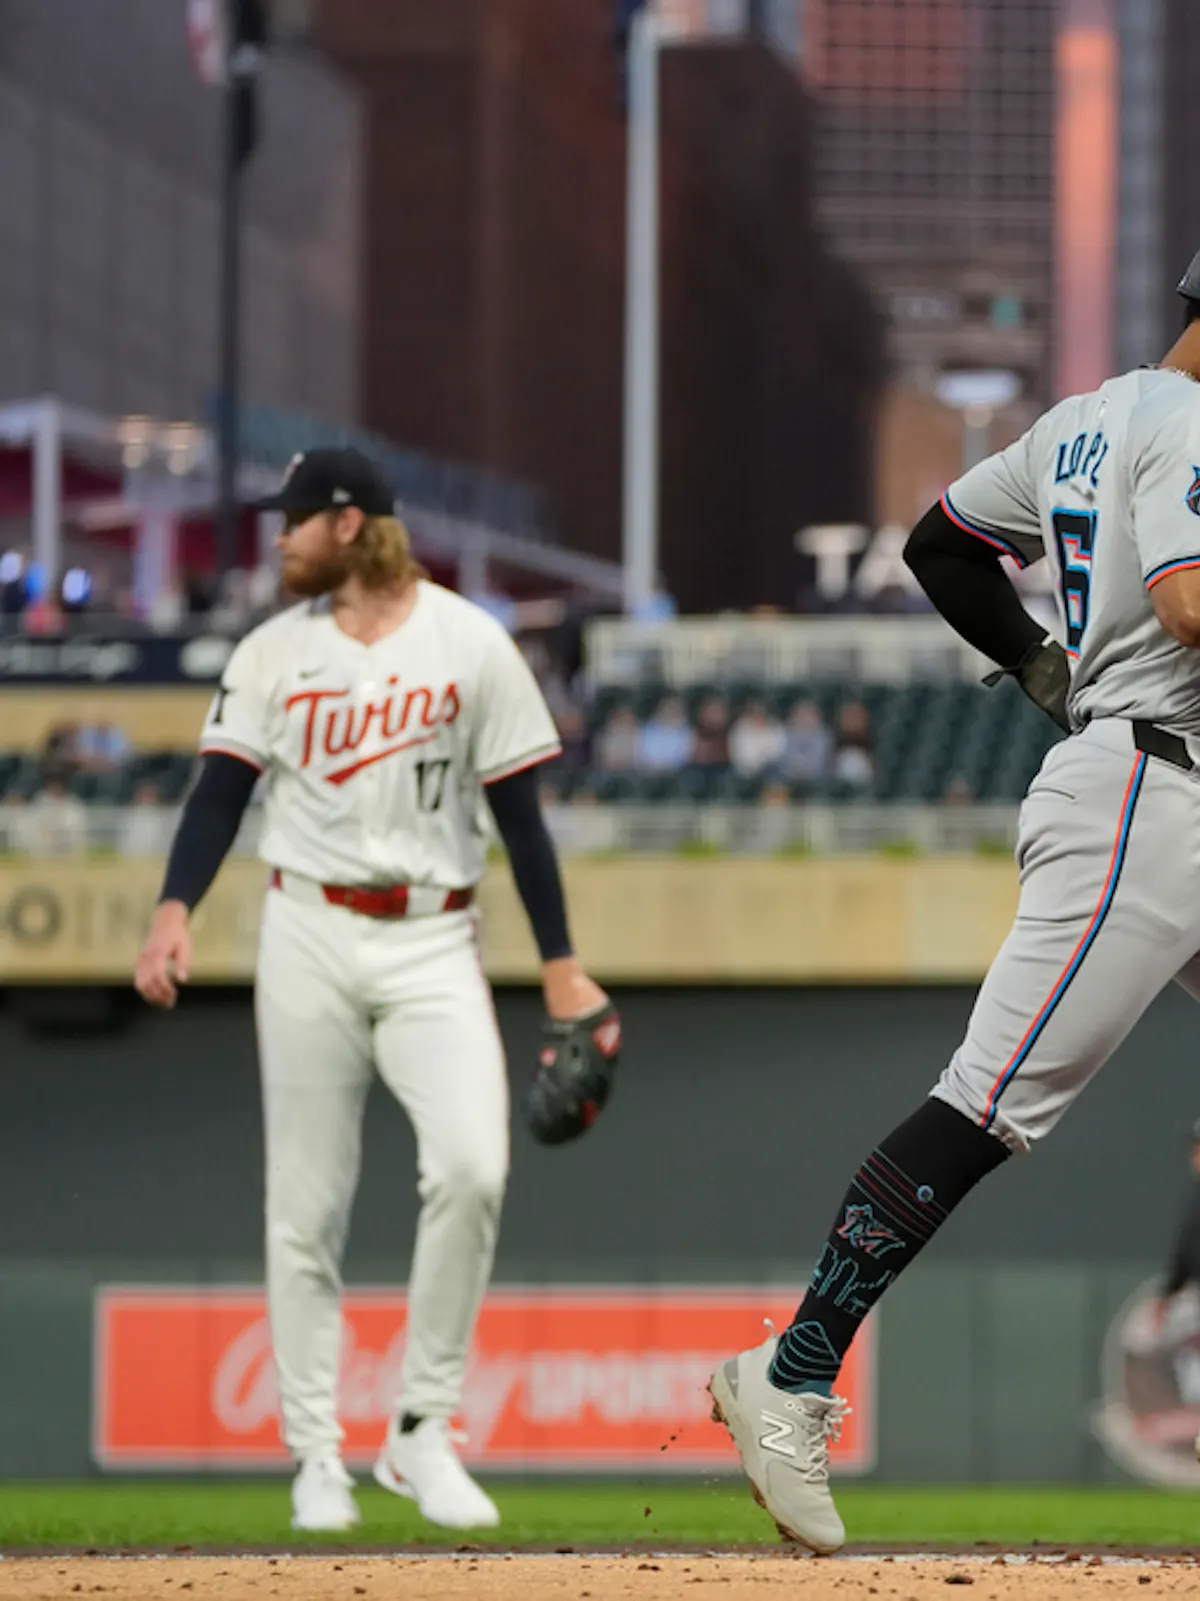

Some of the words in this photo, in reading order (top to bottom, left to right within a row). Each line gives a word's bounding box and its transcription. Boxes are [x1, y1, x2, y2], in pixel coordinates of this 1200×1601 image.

[1051, 507, 1097, 660] 6
[285, 674, 461, 769] Twins
[415, 759, 451, 812] 17
[521, 1350, 713, 1422] SPORT
